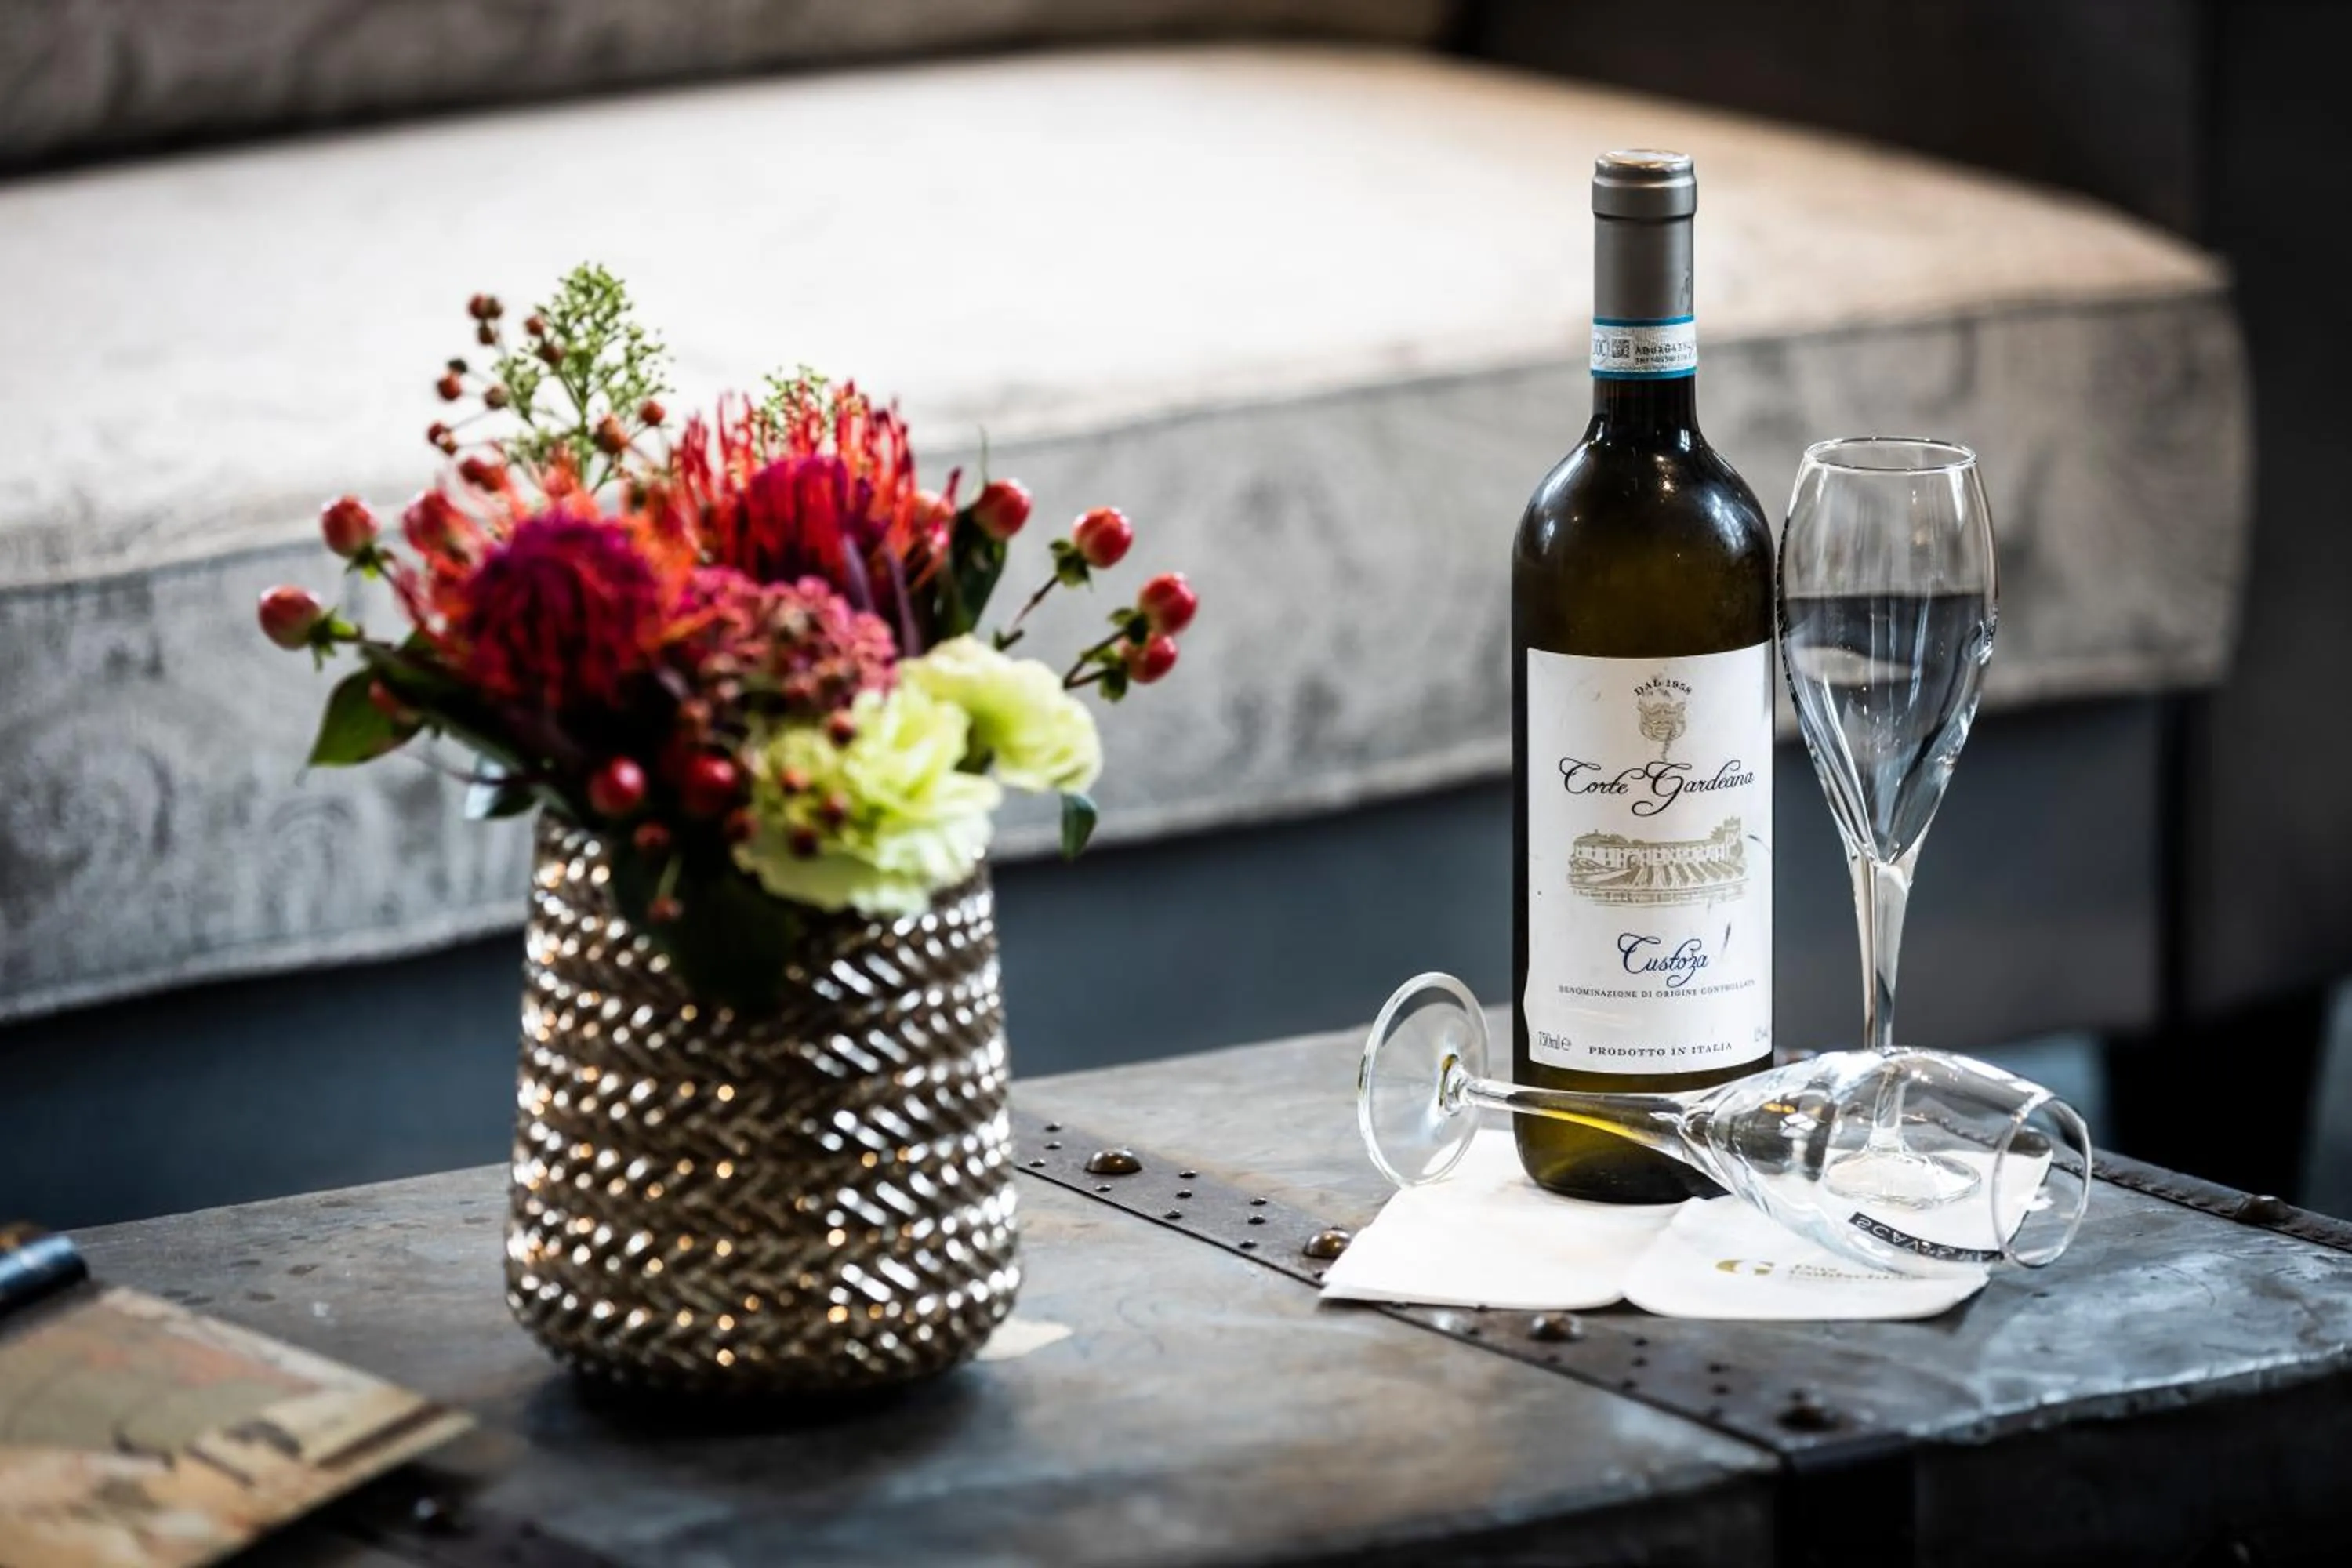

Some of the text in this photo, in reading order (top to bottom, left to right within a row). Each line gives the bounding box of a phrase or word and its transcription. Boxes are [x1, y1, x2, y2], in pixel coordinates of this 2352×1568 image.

[1634, 679, 1661, 696] DAL
[1559, 757, 1646, 795] Corte
[1617, 932, 1709, 989] Custoza
[1559, 985, 1638, 999] DENOMINAZIONE
[1656, 989, 1697, 998] ORIGINE
[1588, 1043, 1733, 1057] PRODOTTO IN ITALIA
